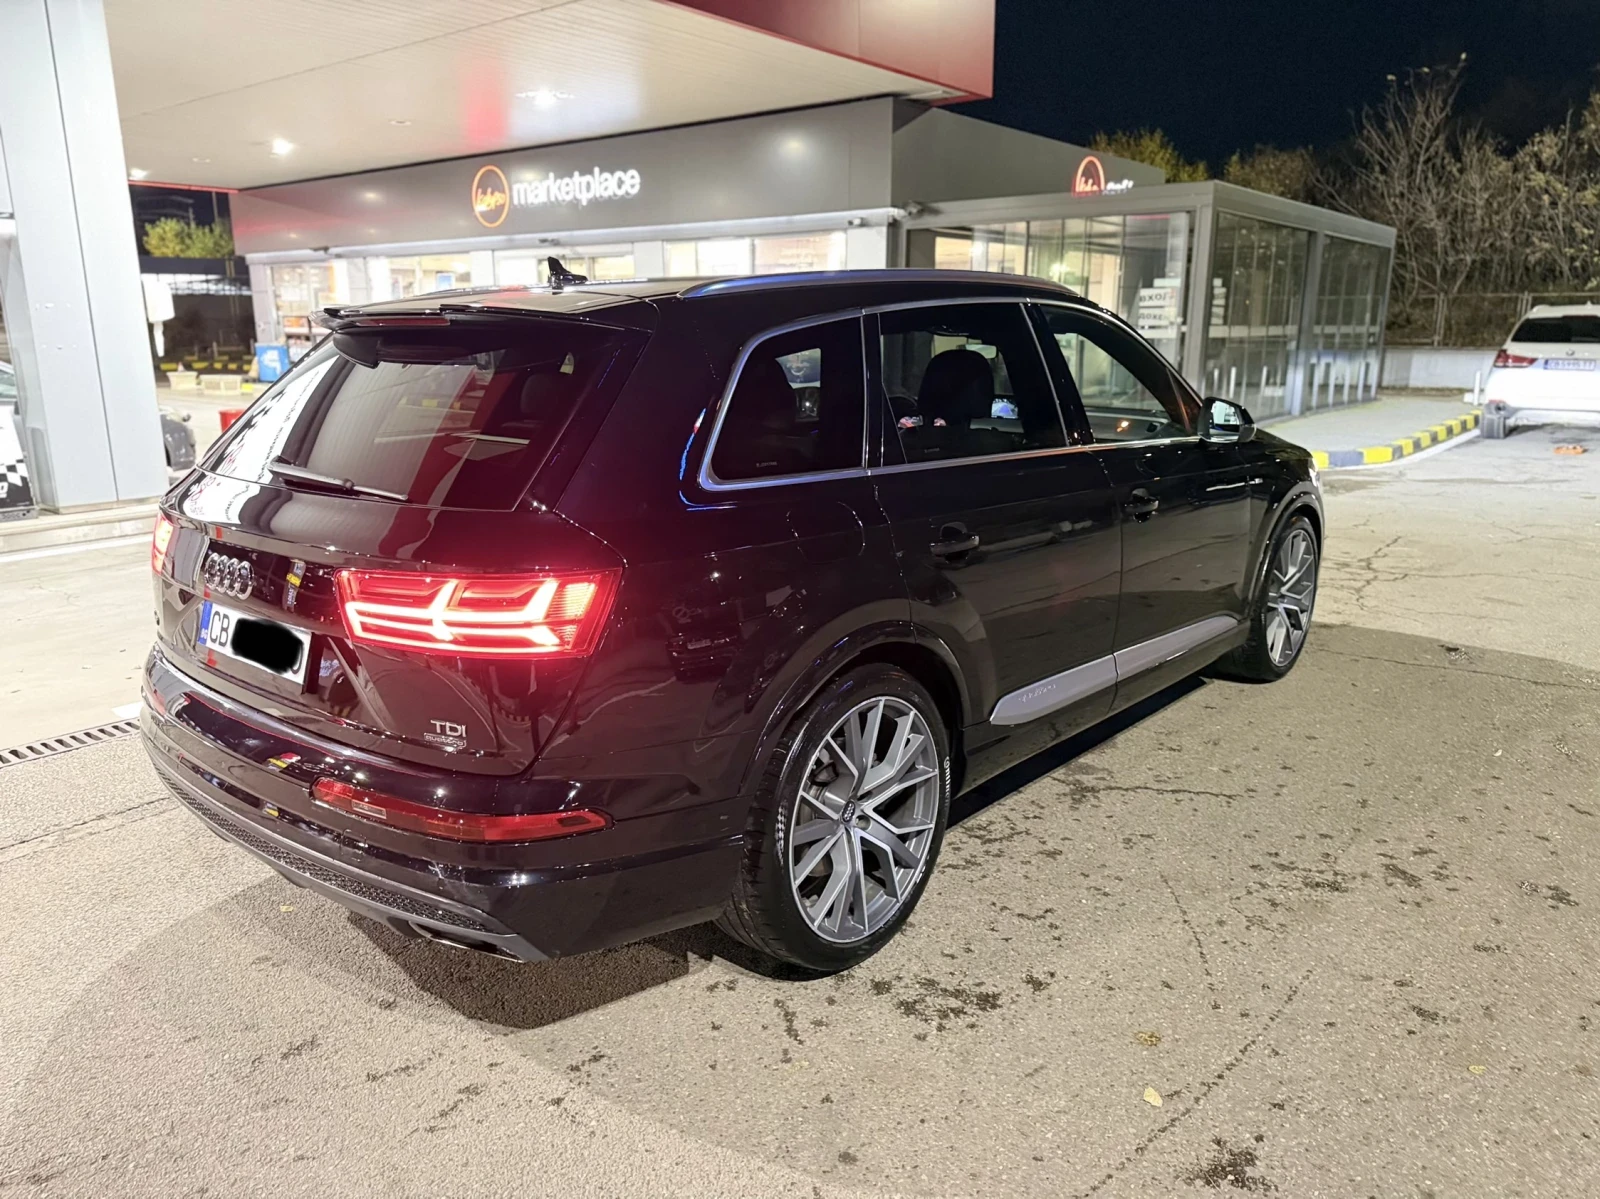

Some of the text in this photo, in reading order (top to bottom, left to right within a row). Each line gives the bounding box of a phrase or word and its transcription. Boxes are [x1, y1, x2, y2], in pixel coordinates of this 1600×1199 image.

[512, 166, 641, 206] marketplace
[209, 610, 231, 648] CB
[430, 719, 467, 738] TDI
